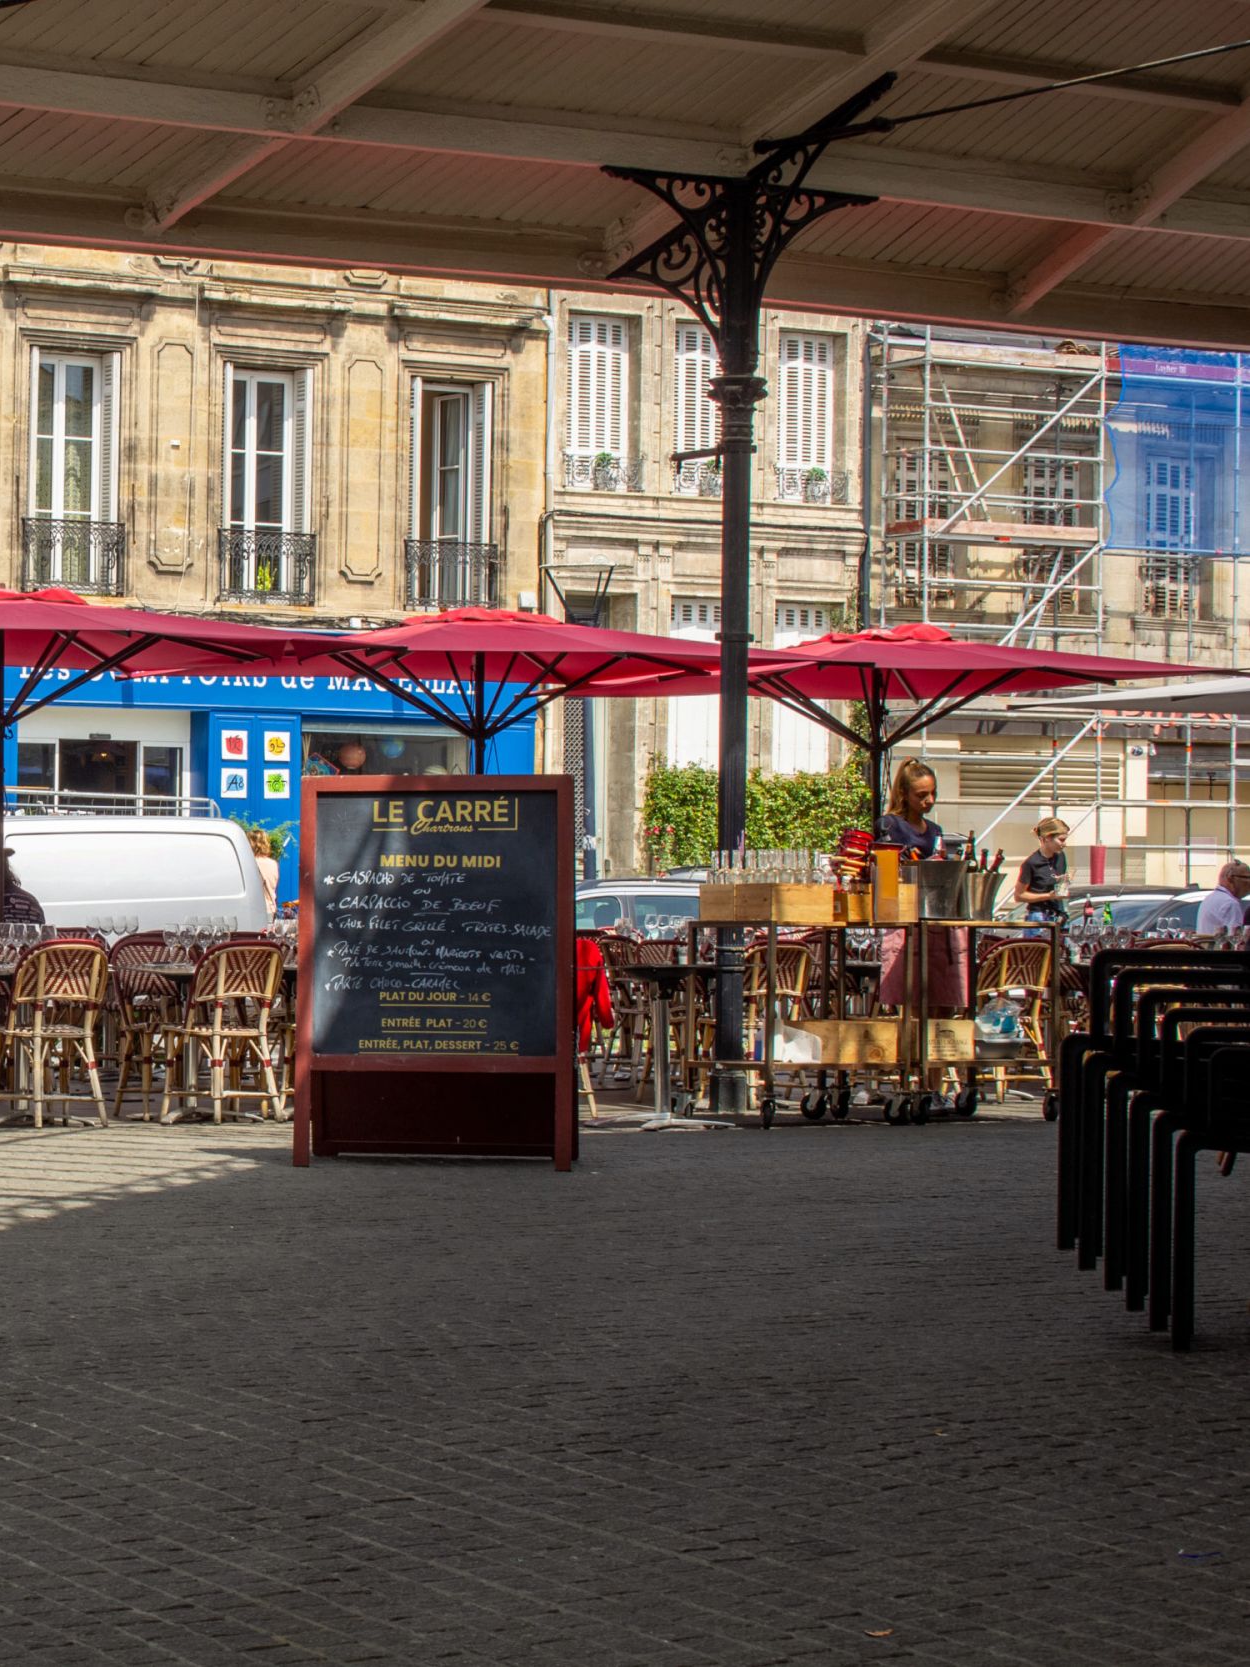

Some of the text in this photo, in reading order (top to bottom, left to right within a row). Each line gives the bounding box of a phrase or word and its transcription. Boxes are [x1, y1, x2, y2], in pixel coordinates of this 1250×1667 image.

[373, 796, 509, 823] LE CARRÉ
[410, 819, 474, 835] Chartrons
[380, 854, 501, 869] MENU DU MIDI
[336, 870, 466, 887] GASPACHO DE TOMATE
[421, 899, 440, 910] DE
[476, 962, 491, 973] de
[379, 991, 406, 1001] PLAT
[408, 992, 425, 1001] DU
[426, 992, 457, 1002] JOUR
[481, 993, 491, 1002] €
[381, 1016, 488, 1029] ENTRÉE PLAT 20 €
[358, 1038, 519, 1050] ENTRÉE, PLAT, DESSERT 25 €
